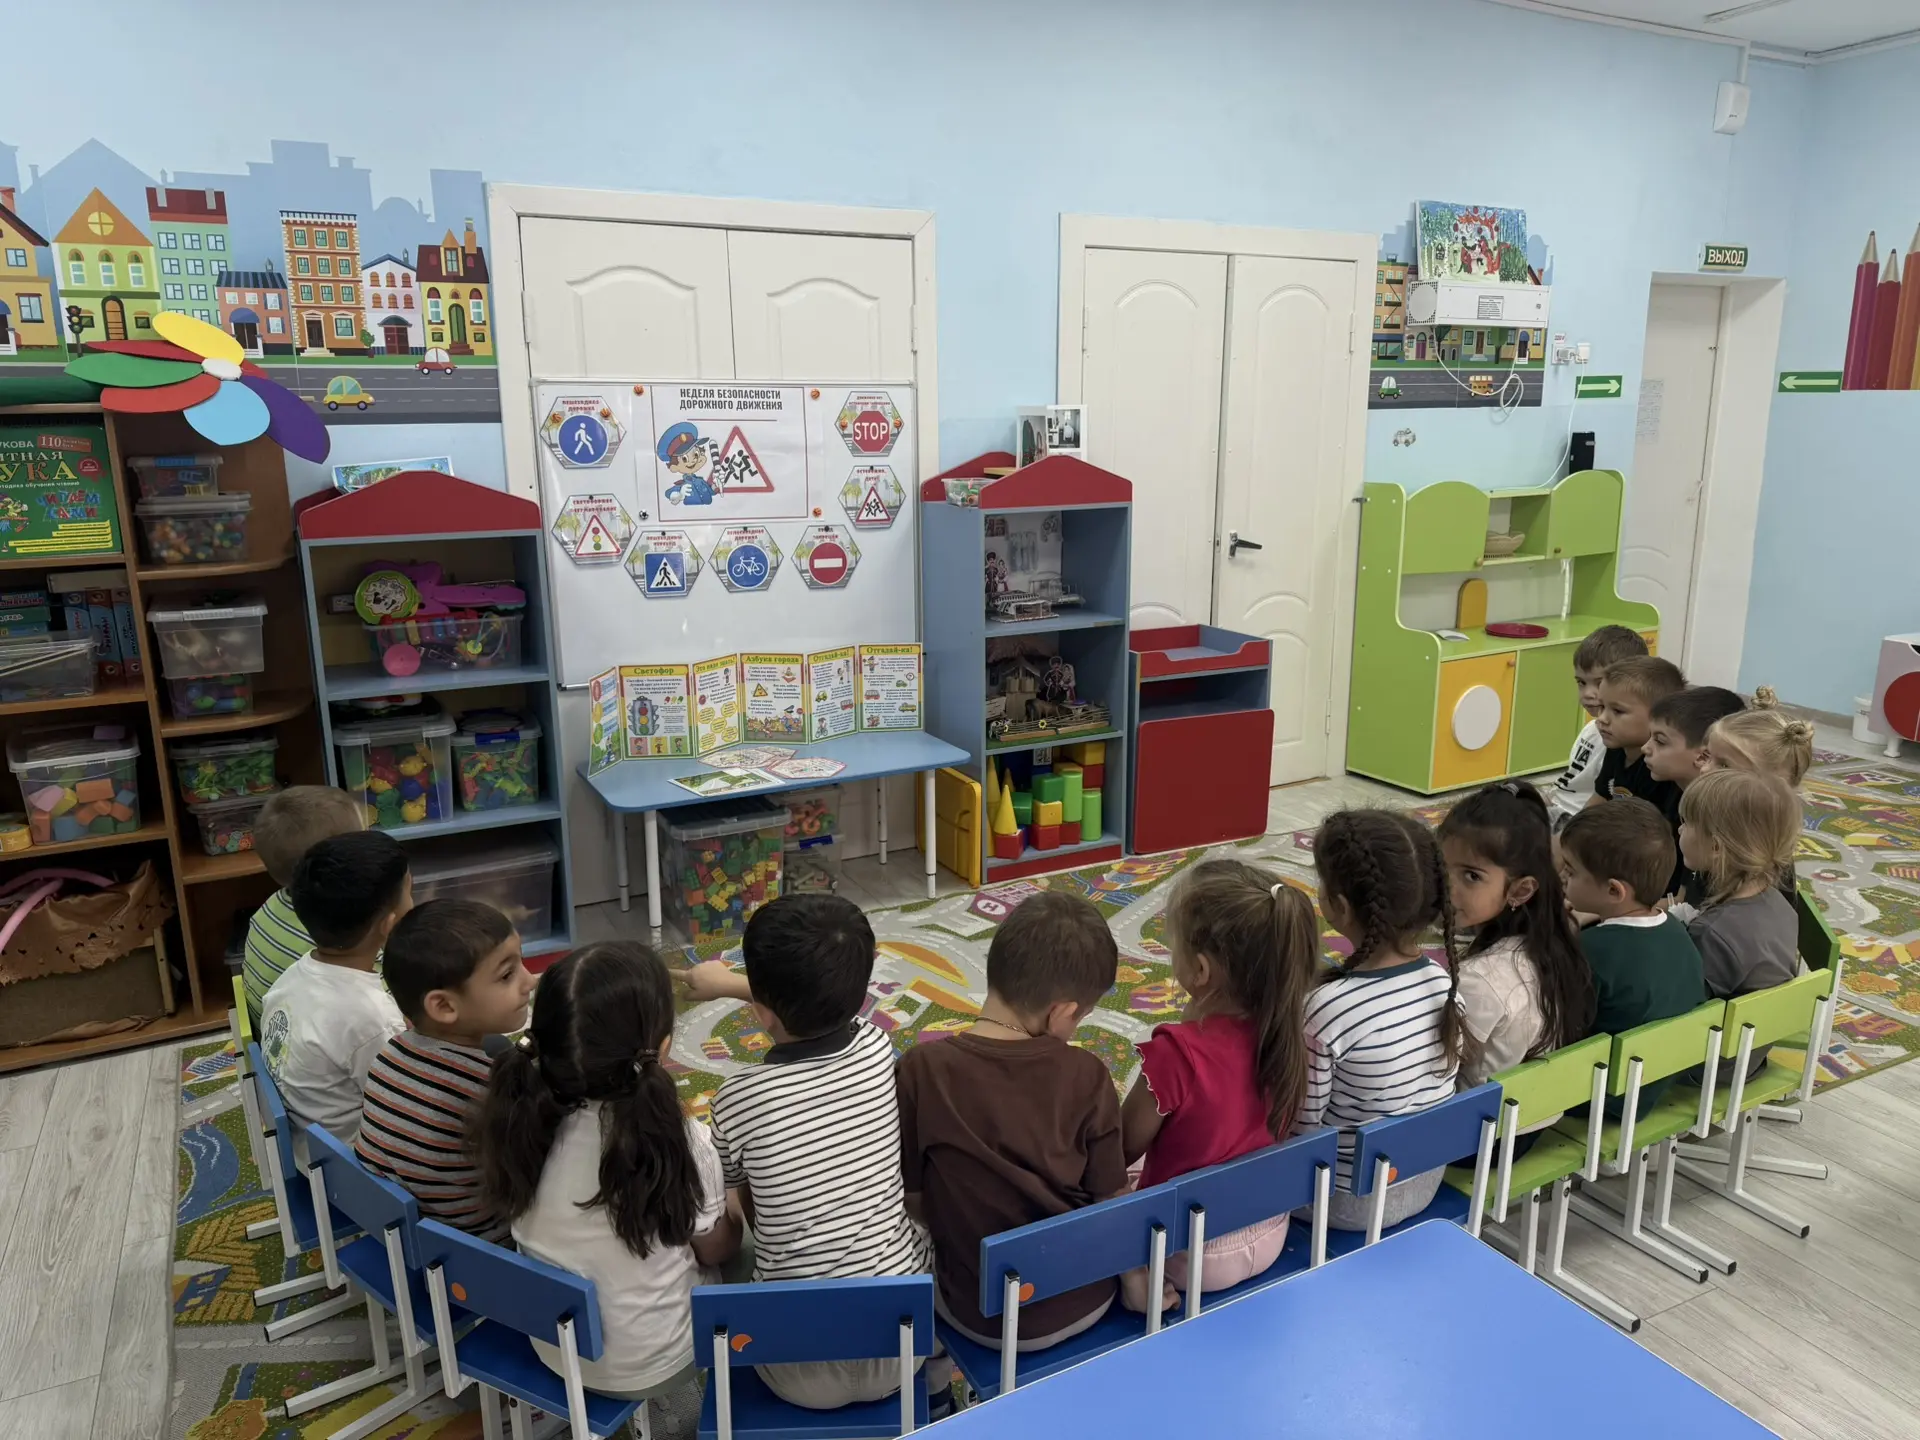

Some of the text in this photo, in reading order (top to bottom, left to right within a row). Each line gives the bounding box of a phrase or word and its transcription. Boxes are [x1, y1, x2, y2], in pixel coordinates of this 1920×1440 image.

[1707, 248, 1745, 266] ВЫХОД
[680, 388, 781, 399] НЕДЕЛЯ БЕЗОПАСНОСТИ
[679, 400, 783, 411] ДОРОЖНОГО ДВИЖЕНИЯ
[854, 422, 888, 441] STOP
[41, 436, 62, 447] 110
[35, 489, 100, 506] ЧИТАЕМ
[47, 506, 98, 519] САМИ
[813, 649, 850, 662] Отгадай-ка!
[866, 646, 913, 654] Отгадай-ка!
[746, 655, 770, 664] Азбука
[633, 667, 674, 675] Светофор
